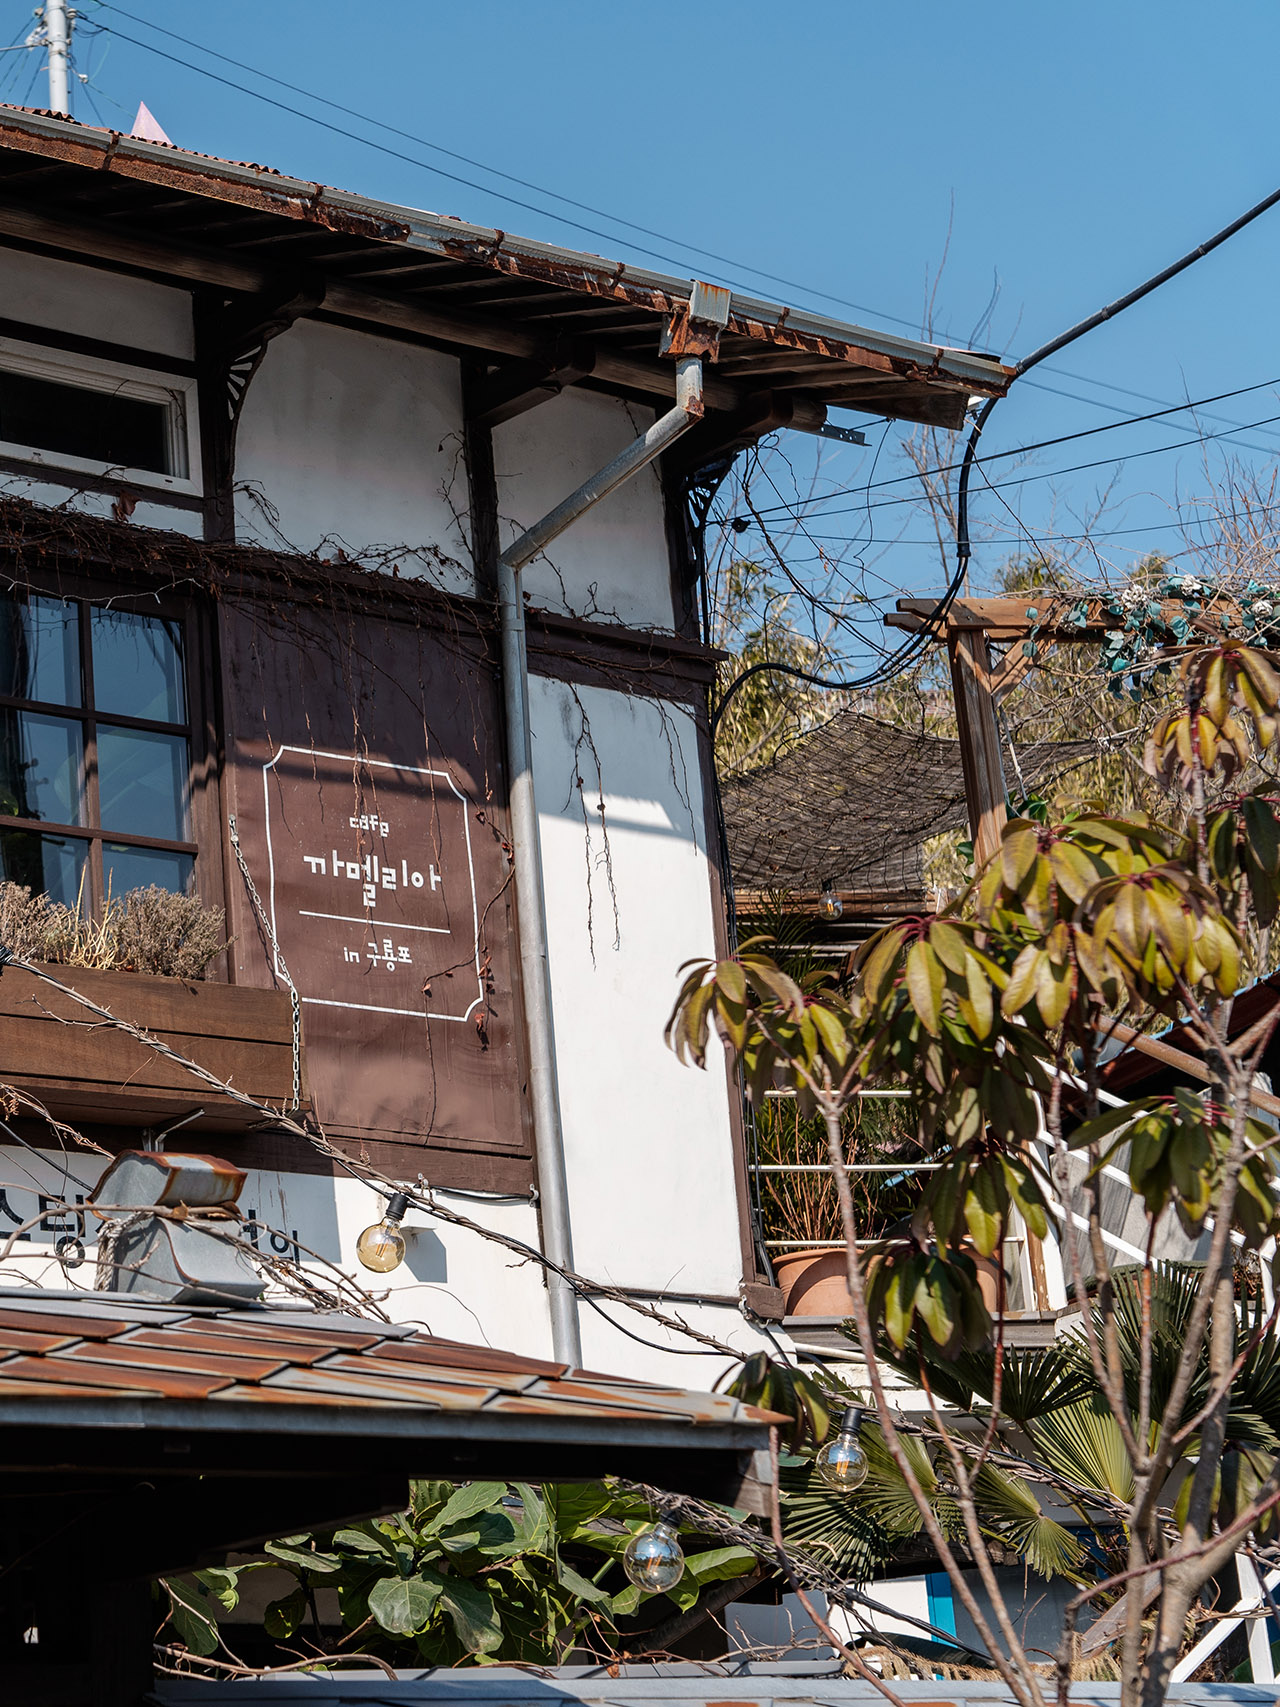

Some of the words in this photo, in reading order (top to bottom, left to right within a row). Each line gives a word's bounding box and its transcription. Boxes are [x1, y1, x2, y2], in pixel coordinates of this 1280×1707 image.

[349, 814, 390, 838] cafe
[303, 849, 442, 908] 까멜리아
[343, 946, 360, 963] in
[366, 938, 413, 972] 구룡포
